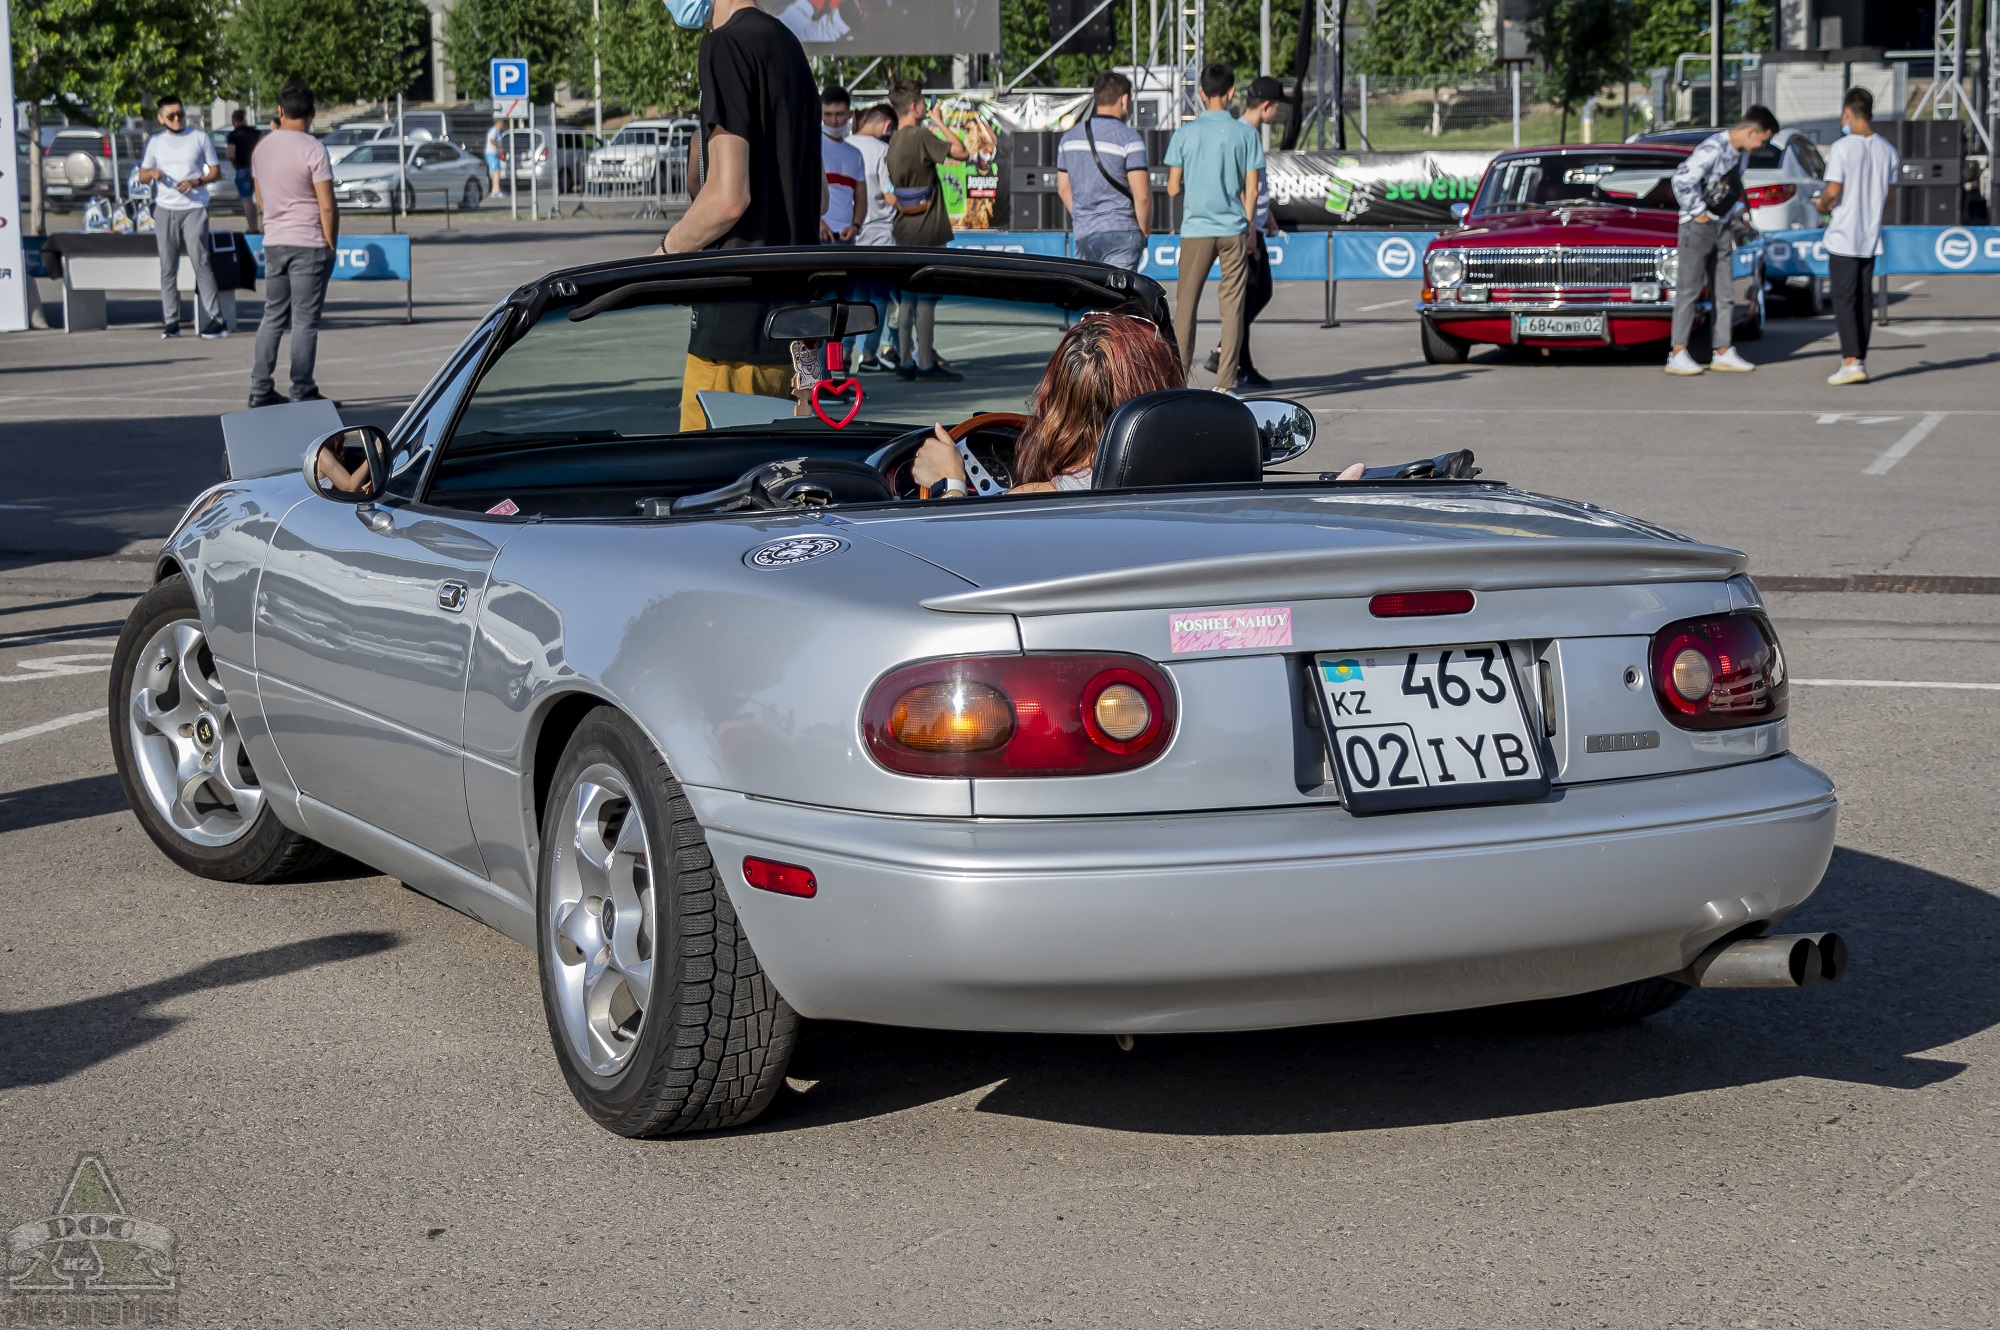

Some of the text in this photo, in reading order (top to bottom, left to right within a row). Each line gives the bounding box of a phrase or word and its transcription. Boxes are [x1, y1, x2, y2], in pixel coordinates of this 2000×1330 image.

[499, 64, 520, 94] P
[1267, 173, 1328, 206] aguar
[1174, 614, 1287, 632] POSHEL NAHUY
[1401, 648, 1506, 709] 463
[1330, 690, 1372, 716] KZ
[1345, 732, 1529, 789] 02 IYB
